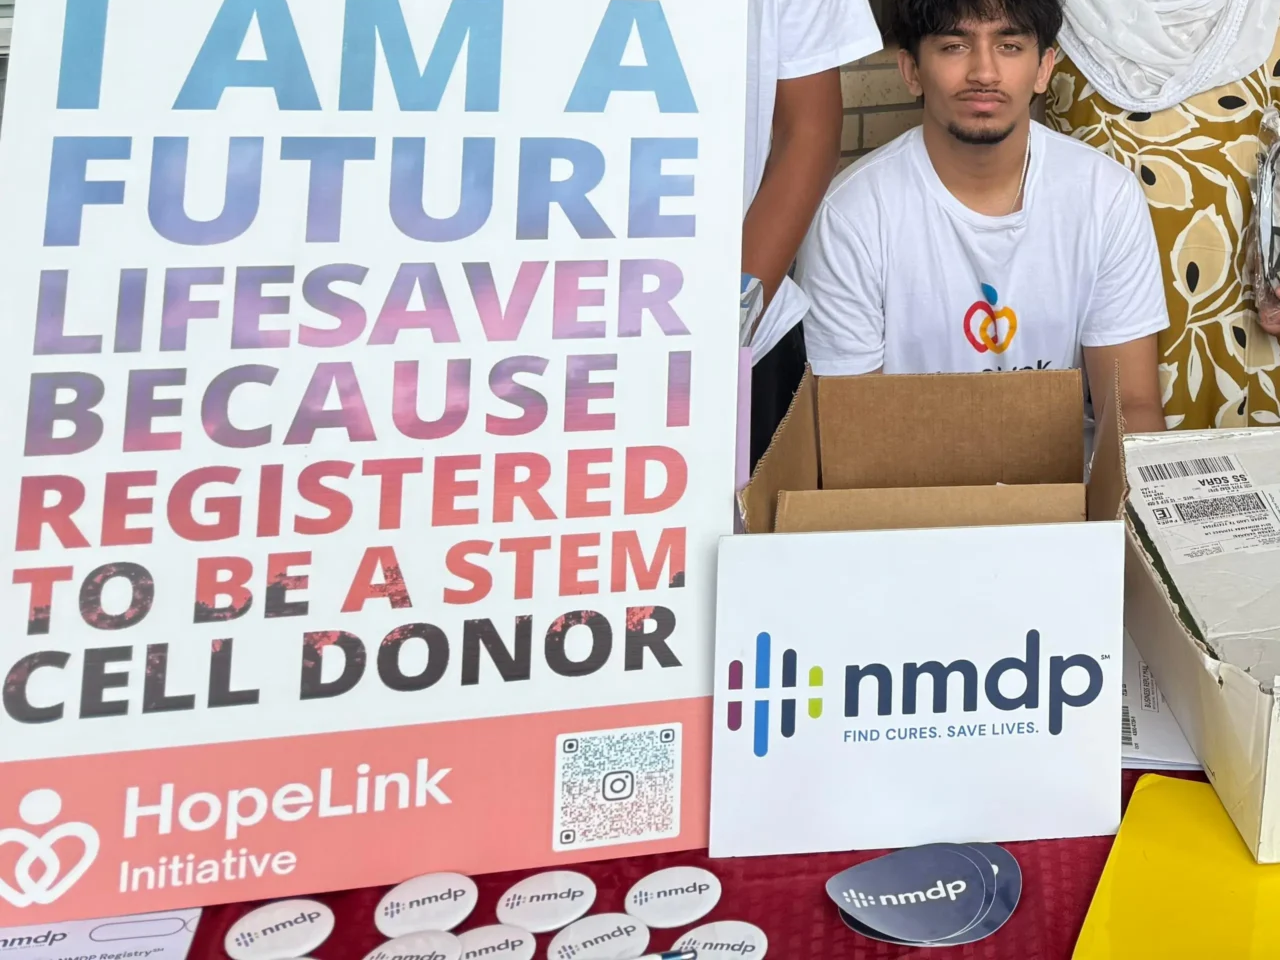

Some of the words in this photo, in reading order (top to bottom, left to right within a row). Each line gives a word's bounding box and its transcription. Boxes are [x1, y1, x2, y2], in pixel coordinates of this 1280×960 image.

[43, 135, 699, 247] FUTURE
[32, 258, 692, 355] LIFESAVER
[22, 354, 618, 457] BECAUSE
[666, 351, 692, 427] I
[1198, 476, 1230, 487] SGRA
[1232, 474, 1248, 482] SS
[14, 444, 689, 552] REGISTERED
[12, 561, 156, 636] TO
[193, 550, 312, 624] BE
[340, 545, 413, 613] A
[443, 527, 687, 605] STEM
[2, 637, 260, 725] CELL
[299, 604, 683, 701] DONOR
[844, 629, 1103, 736] nmdp
[1142, 675, 1150, 688] REPLY
[1143, 687, 1152, 708] BUSINESS
[844, 729, 880, 743] FIND
[885, 726, 942, 741] CURES.
[947, 723, 987, 738] SAVE
[992, 721, 1039, 735] LIVES.
[122, 758, 453, 839] HopeLink
[119, 849, 297, 894] Initiative
[408, 888, 466, 909] nmdp
[529, 888, 584, 904] nmdp
[656, 882, 710, 899] nmdp
[879, 879, 967, 907] nmdp
[261, 910, 321, 937] nmdp
[0, 930, 67, 947] nmdp
[465, 939, 524, 959] nmdp
[581, 923, 636, 951] nmdp
[701, 940, 756, 955] nmdp
[99, 949, 152, 960] Registry
